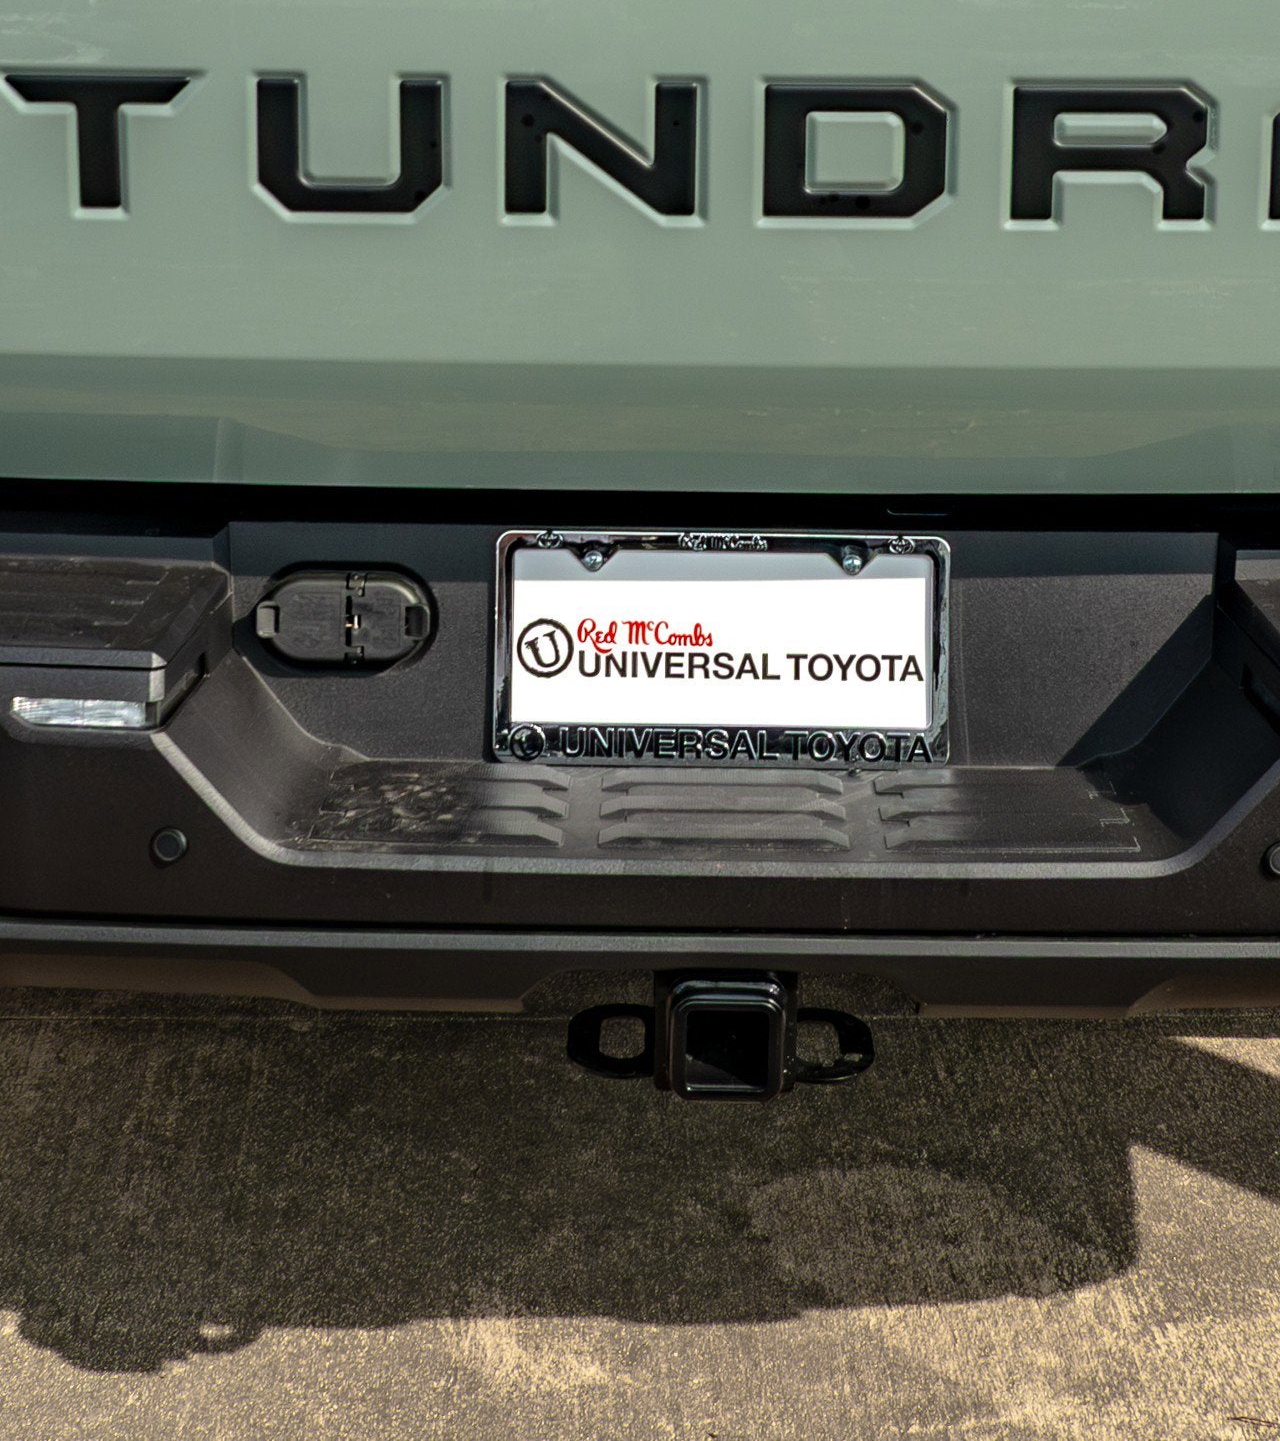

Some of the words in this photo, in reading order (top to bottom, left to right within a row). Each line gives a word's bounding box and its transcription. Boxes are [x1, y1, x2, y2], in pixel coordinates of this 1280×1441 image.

[577, 618, 618, 655] Red
[621, 620, 714, 647] McCombs
[578, 649, 781, 681] UNIVERSAL
[786, 653, 925, 683] TOYOTA
[558, 726, 780, 760] UNIVERSAL
[786, 730, 934, 764] TOYOTA
